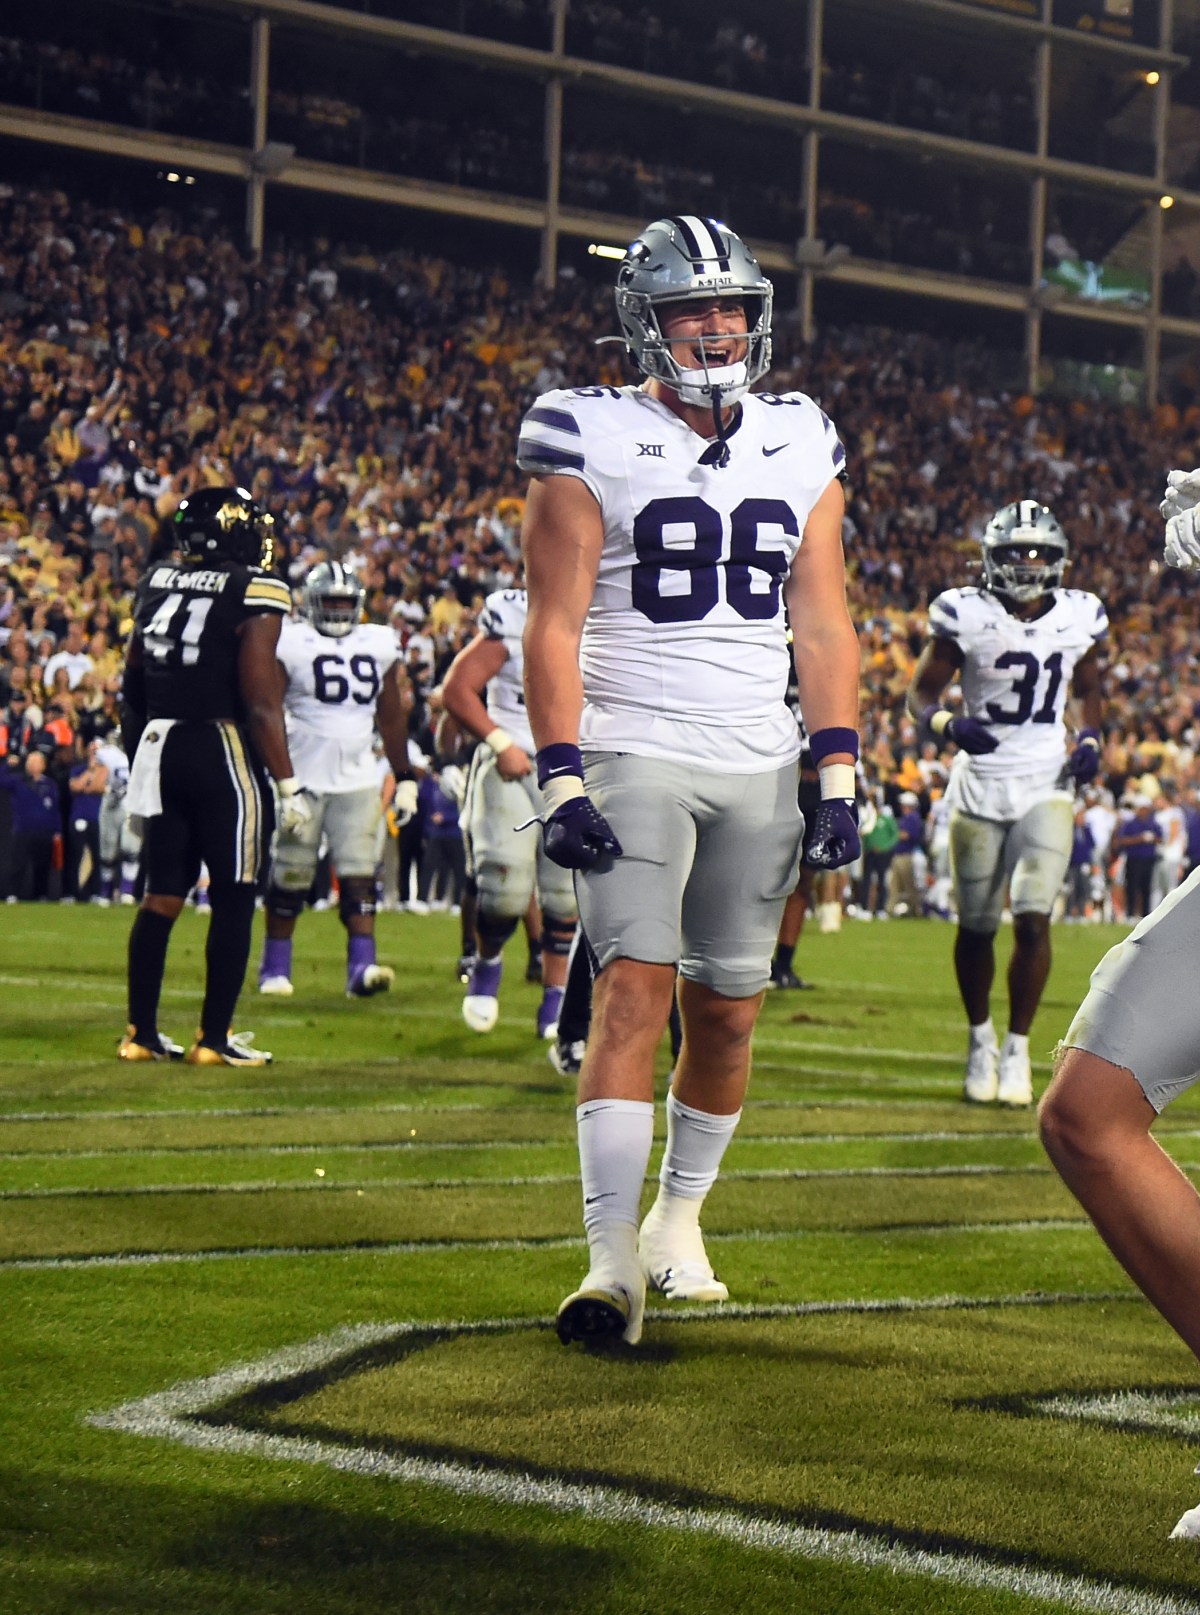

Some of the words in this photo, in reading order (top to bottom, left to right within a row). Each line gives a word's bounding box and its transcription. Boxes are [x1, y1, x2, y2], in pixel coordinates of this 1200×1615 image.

[698, 276, 734, 287] K-STATE
[635, 442, 666, 459] XII
[631, 496, 800, 624] 86
[142, 593, 214, 667] 41
[312, 653, 380, 706] 69
[984, 650, 1063, 725] 31
